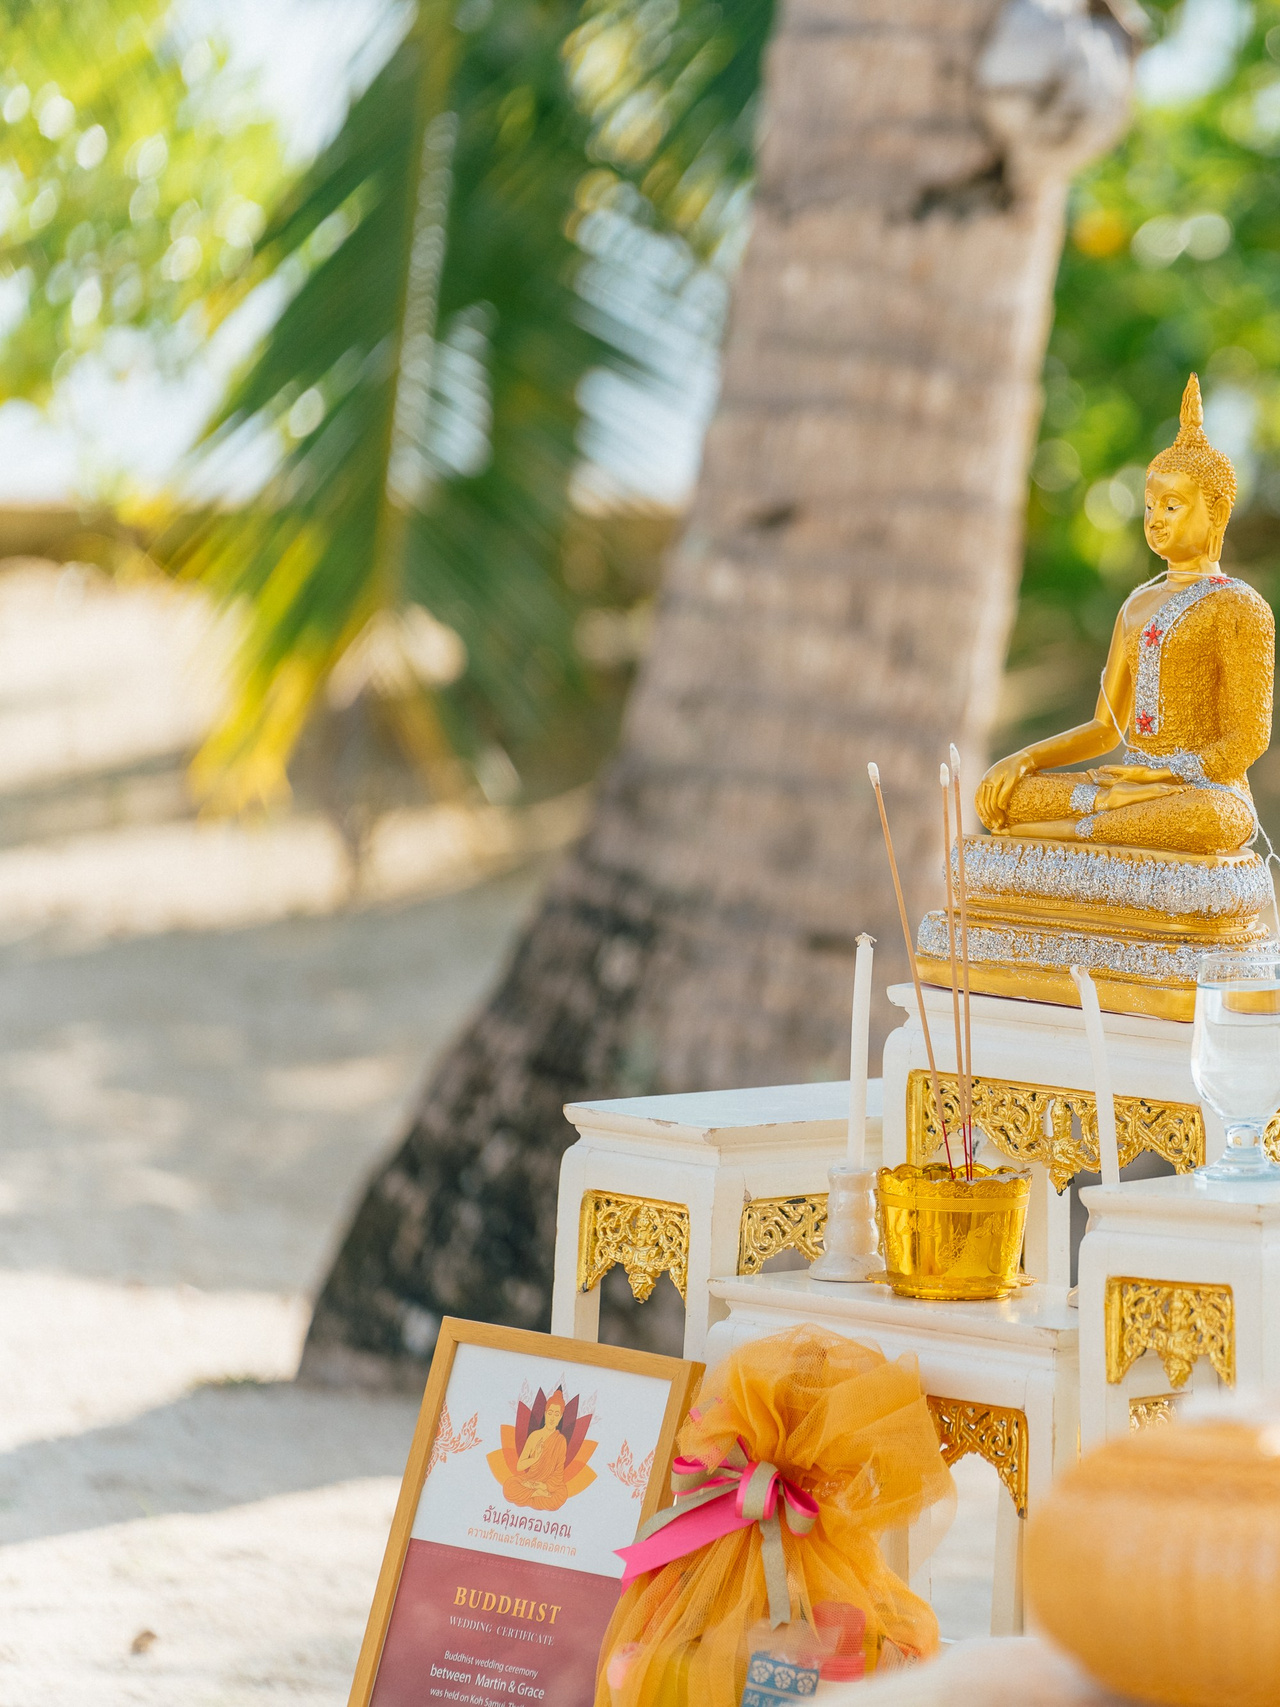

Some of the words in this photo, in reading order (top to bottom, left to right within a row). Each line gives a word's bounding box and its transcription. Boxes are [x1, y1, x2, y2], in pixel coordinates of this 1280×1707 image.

[453, 1586, 561, 1624] BUDDHIST
[449, 1615, 492, 1633] WEDDING
[497, 1625, 554, 1646] CERTIFICATE
[444, 1650, 474, 1665] Buddhist
[475, 1658, 504, 1672] wedding
[505, 1664, 538, 1680] ceremony
[430, 1663, 471, 1684] between
[475, 1673, 506, 1691] Martin
[508, 1680, 516, 1693] &
[518, 1682, 545, 1699] Grace
[430, 1687, 443, 1697] was
[444, 1690, 459, 1701] held
[460, 1694, 469, 1702] on
[470, 1694, 484, 1705] Koh
